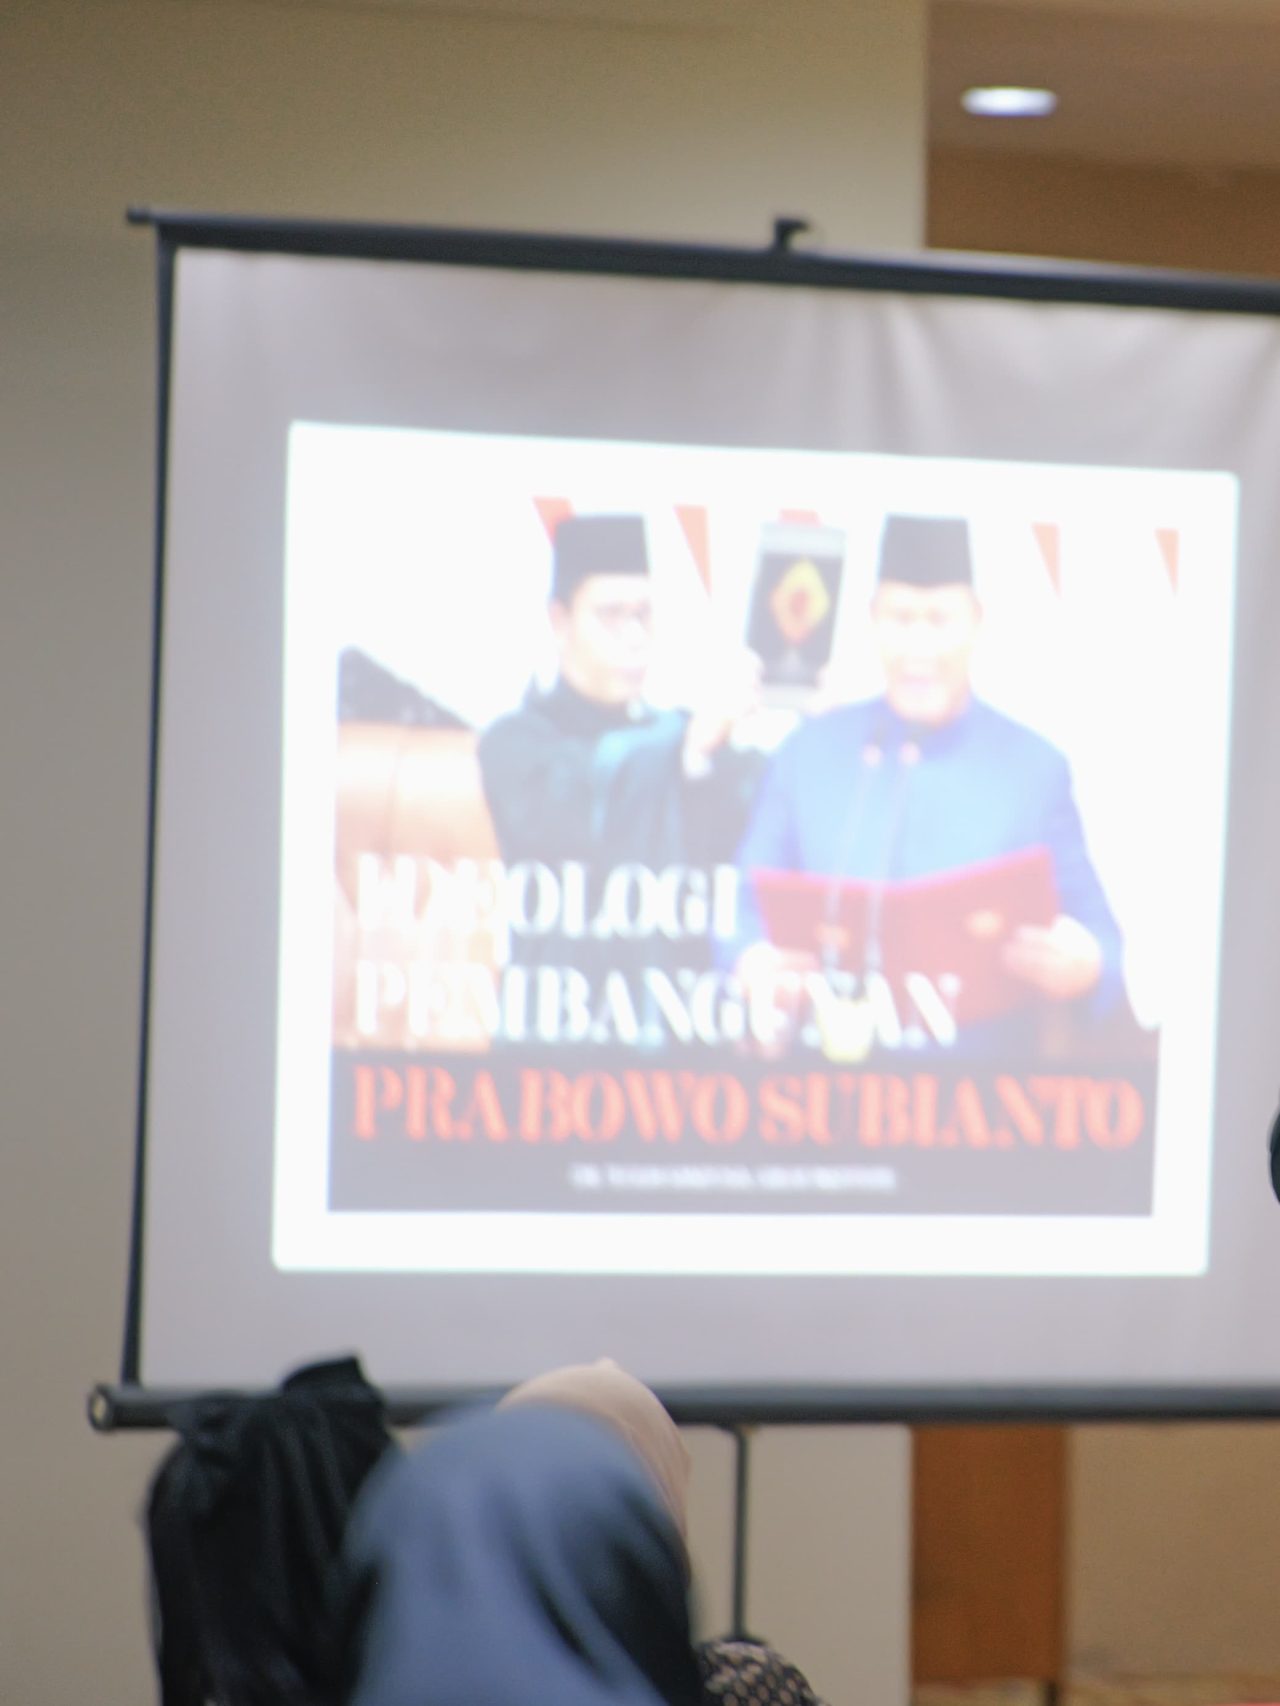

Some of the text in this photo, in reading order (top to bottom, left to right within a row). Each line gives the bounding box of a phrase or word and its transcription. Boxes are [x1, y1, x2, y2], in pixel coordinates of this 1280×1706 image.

[357, 854, 736, 938] IDEOLOGI
[355, 960, 960, 1045] PEMBANGUNAN
[354, 1065, 1142, 1148] PRABOWO SUBIANTO
